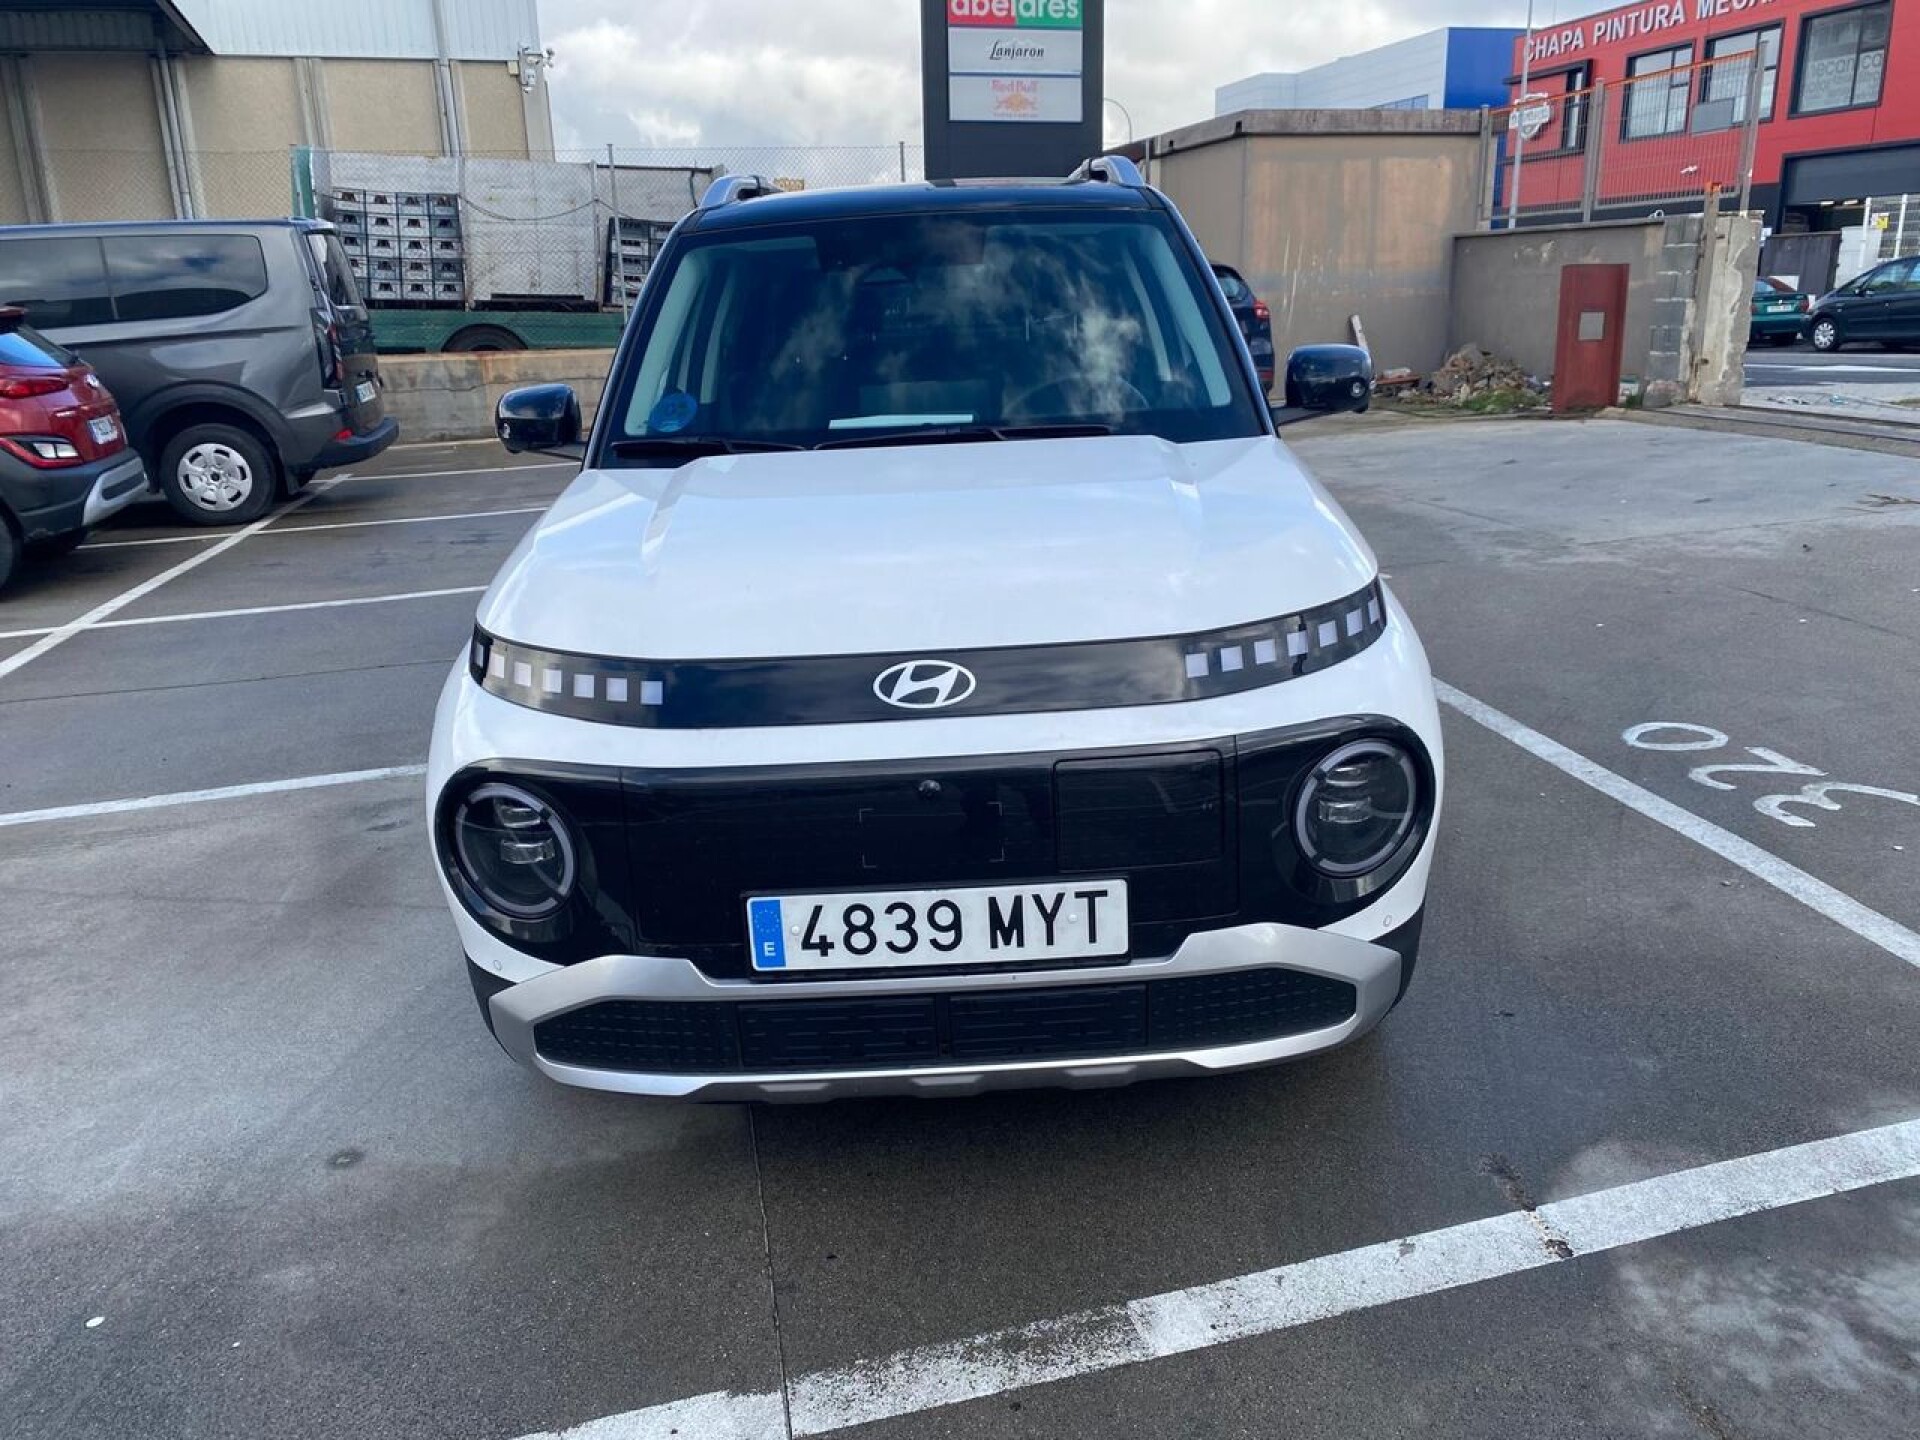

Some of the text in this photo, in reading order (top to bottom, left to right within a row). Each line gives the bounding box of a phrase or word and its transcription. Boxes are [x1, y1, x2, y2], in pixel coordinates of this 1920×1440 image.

[1524, 26, 1585, 61] CHAPA
[1592, 2, 1686, 45] PINTURA
[764, 890, 1108, 957] E 4839 MYT
